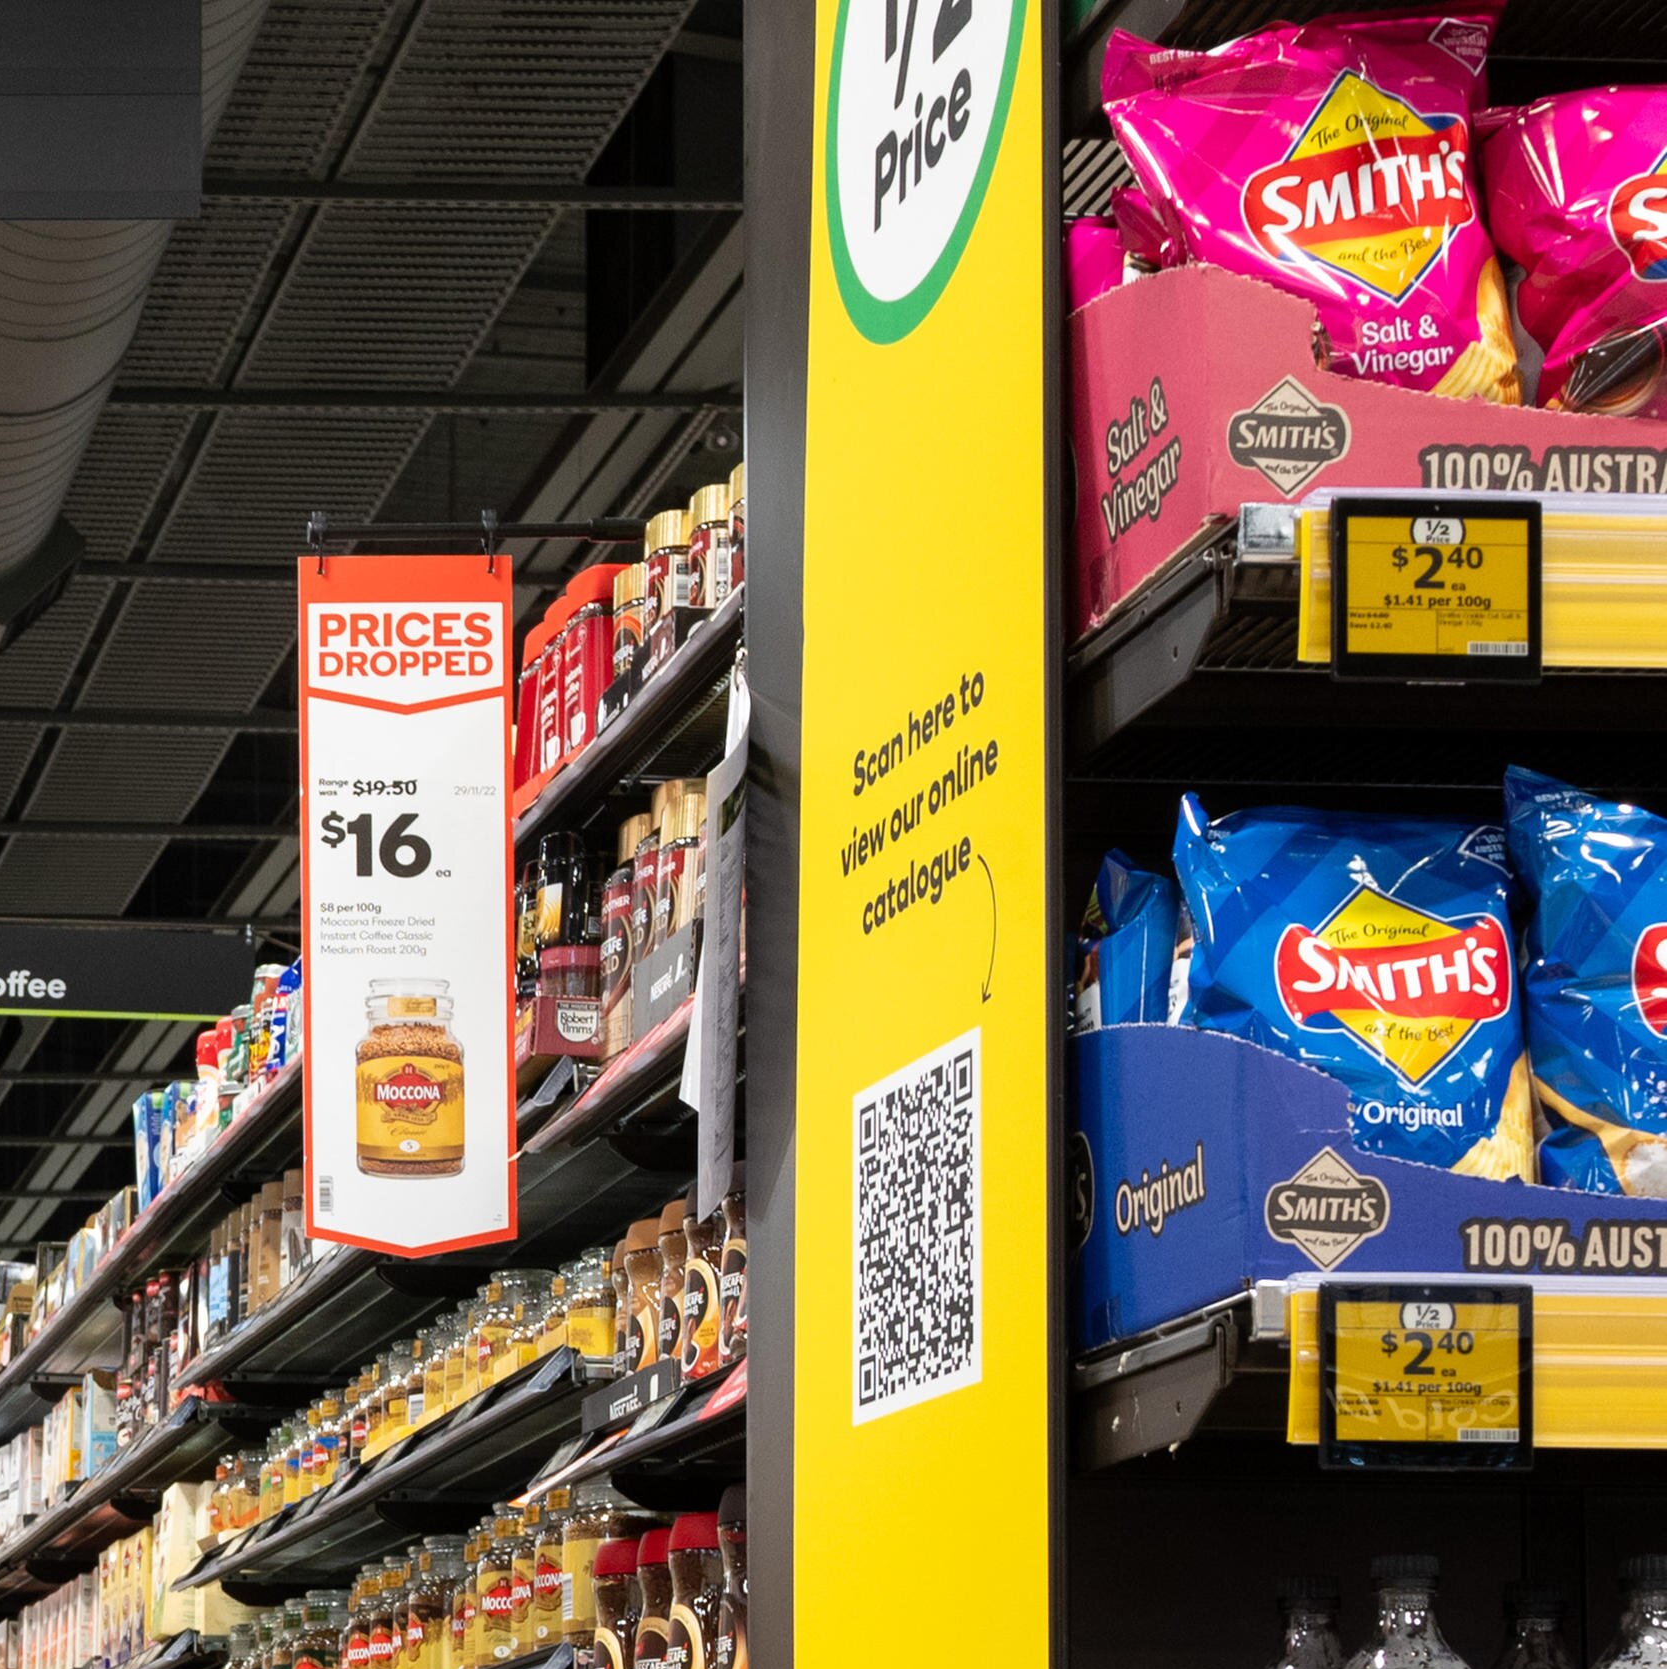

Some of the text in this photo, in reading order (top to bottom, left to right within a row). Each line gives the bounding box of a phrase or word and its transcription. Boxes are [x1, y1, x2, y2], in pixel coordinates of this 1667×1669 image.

[1311, 112, 1409, 150] The Original
[1260, 140, 1466, 233] SMITH'S
[1361, 314, 1439, 345] Salt &
[1351, 344, 1453, 377] Vinegar
[1236, 418, 1338, 451] SMITH'S
[1424, 451, 1534, 492] 100%
[1102, 438, 1182, 542] Vinegar
[1384, 594, 1491, 609] $1.41 per 100g
[319, 612, 493, 648] PRICES
[319, 651, 493, 677] DROPPED
[853, 671, 984, 796] Scan here to
[319, 778, 497, 797] Range $19.50 29/11/22
[319, 788, 338, 797] was
[841, 739, 999, 877] view our online
[435, 868, 452, 878] ea
[862, 836, 971, 935] catalogue
[320, 902, 382, 915] $8 per 100g
[320, 916, 436, 927] Moccona Freeze Dried
[320, 930, 434, 941] Instant Coffee Classic
[320, 944, 427, 957] Medium Roast 200g
[377, 1084, 441, 1101] MOCCONA
[1372, 1381, 1482, 1396] $1.41 per 100g
